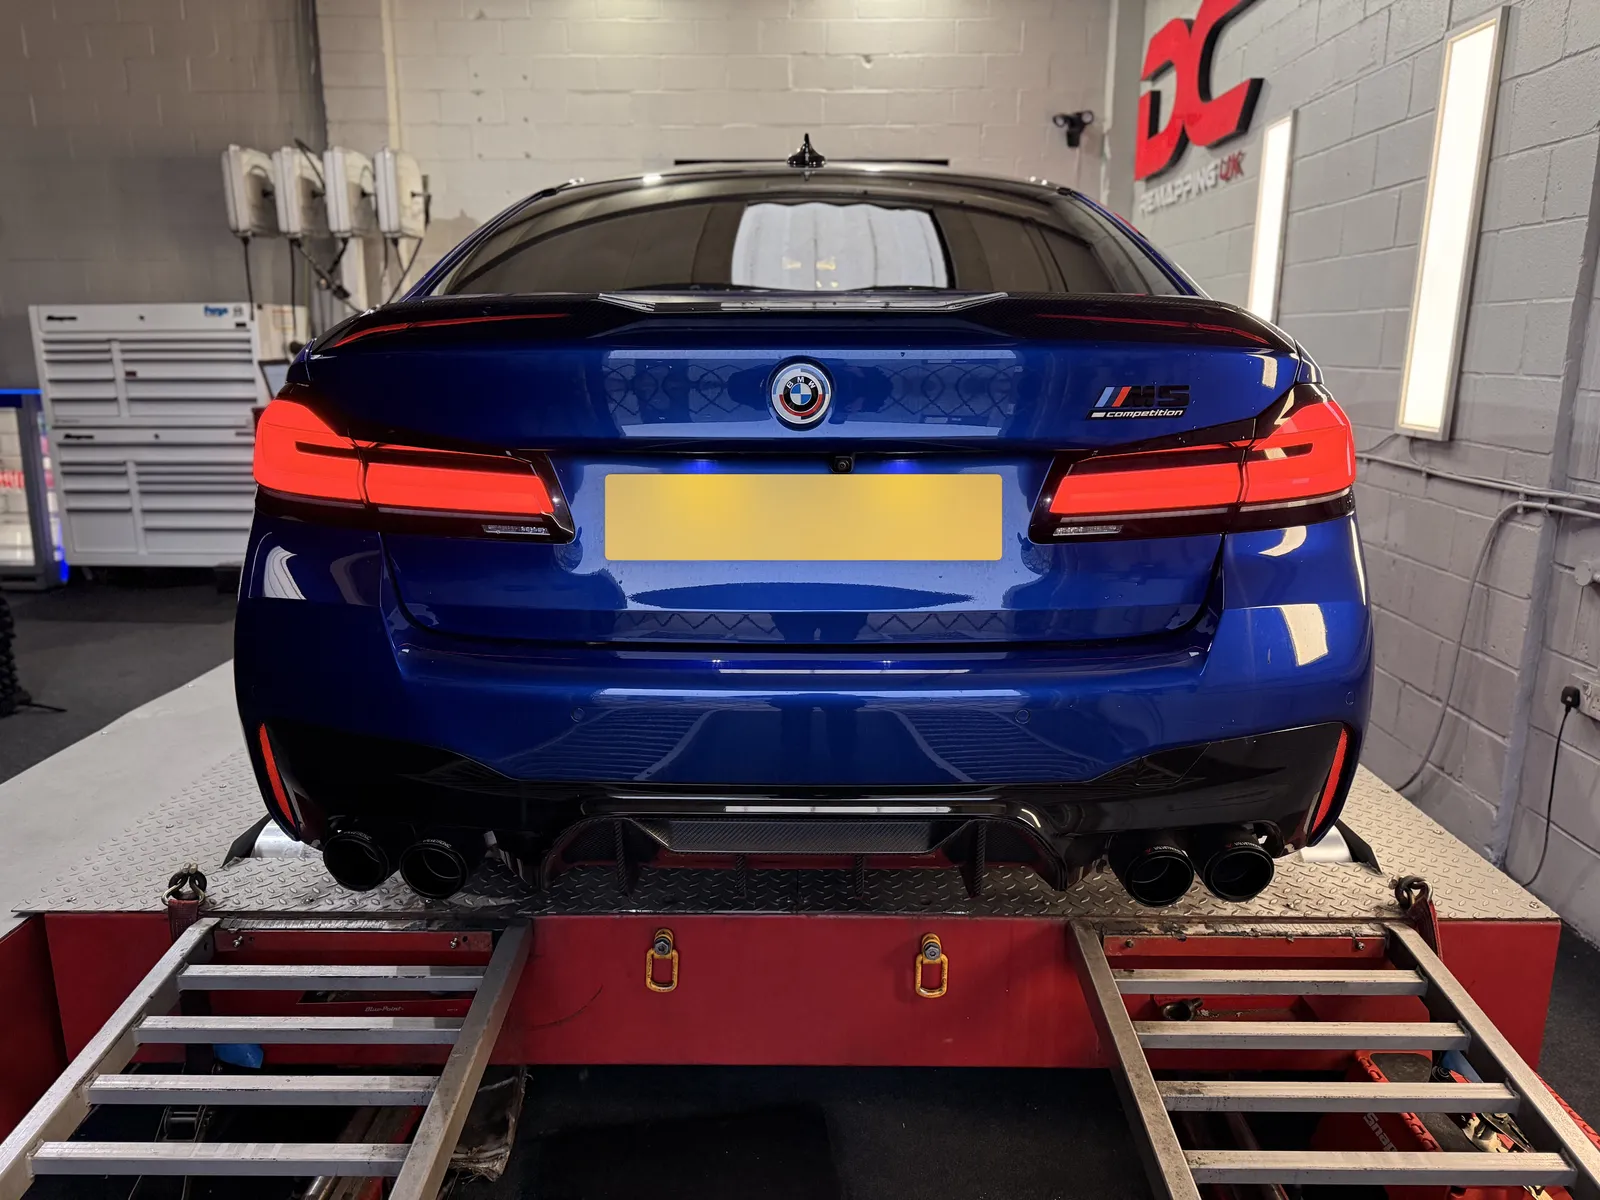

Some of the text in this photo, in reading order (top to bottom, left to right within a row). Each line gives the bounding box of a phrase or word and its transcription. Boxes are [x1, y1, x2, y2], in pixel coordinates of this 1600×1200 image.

[1133, 0, 1265, 182] DC
[1138, 160, 1218, 214] REMAPPING
[786, 376, 816, 389] BMW
[1117, 385, 1190, 408] M5
[1106, 408, 1184, 419] competition
